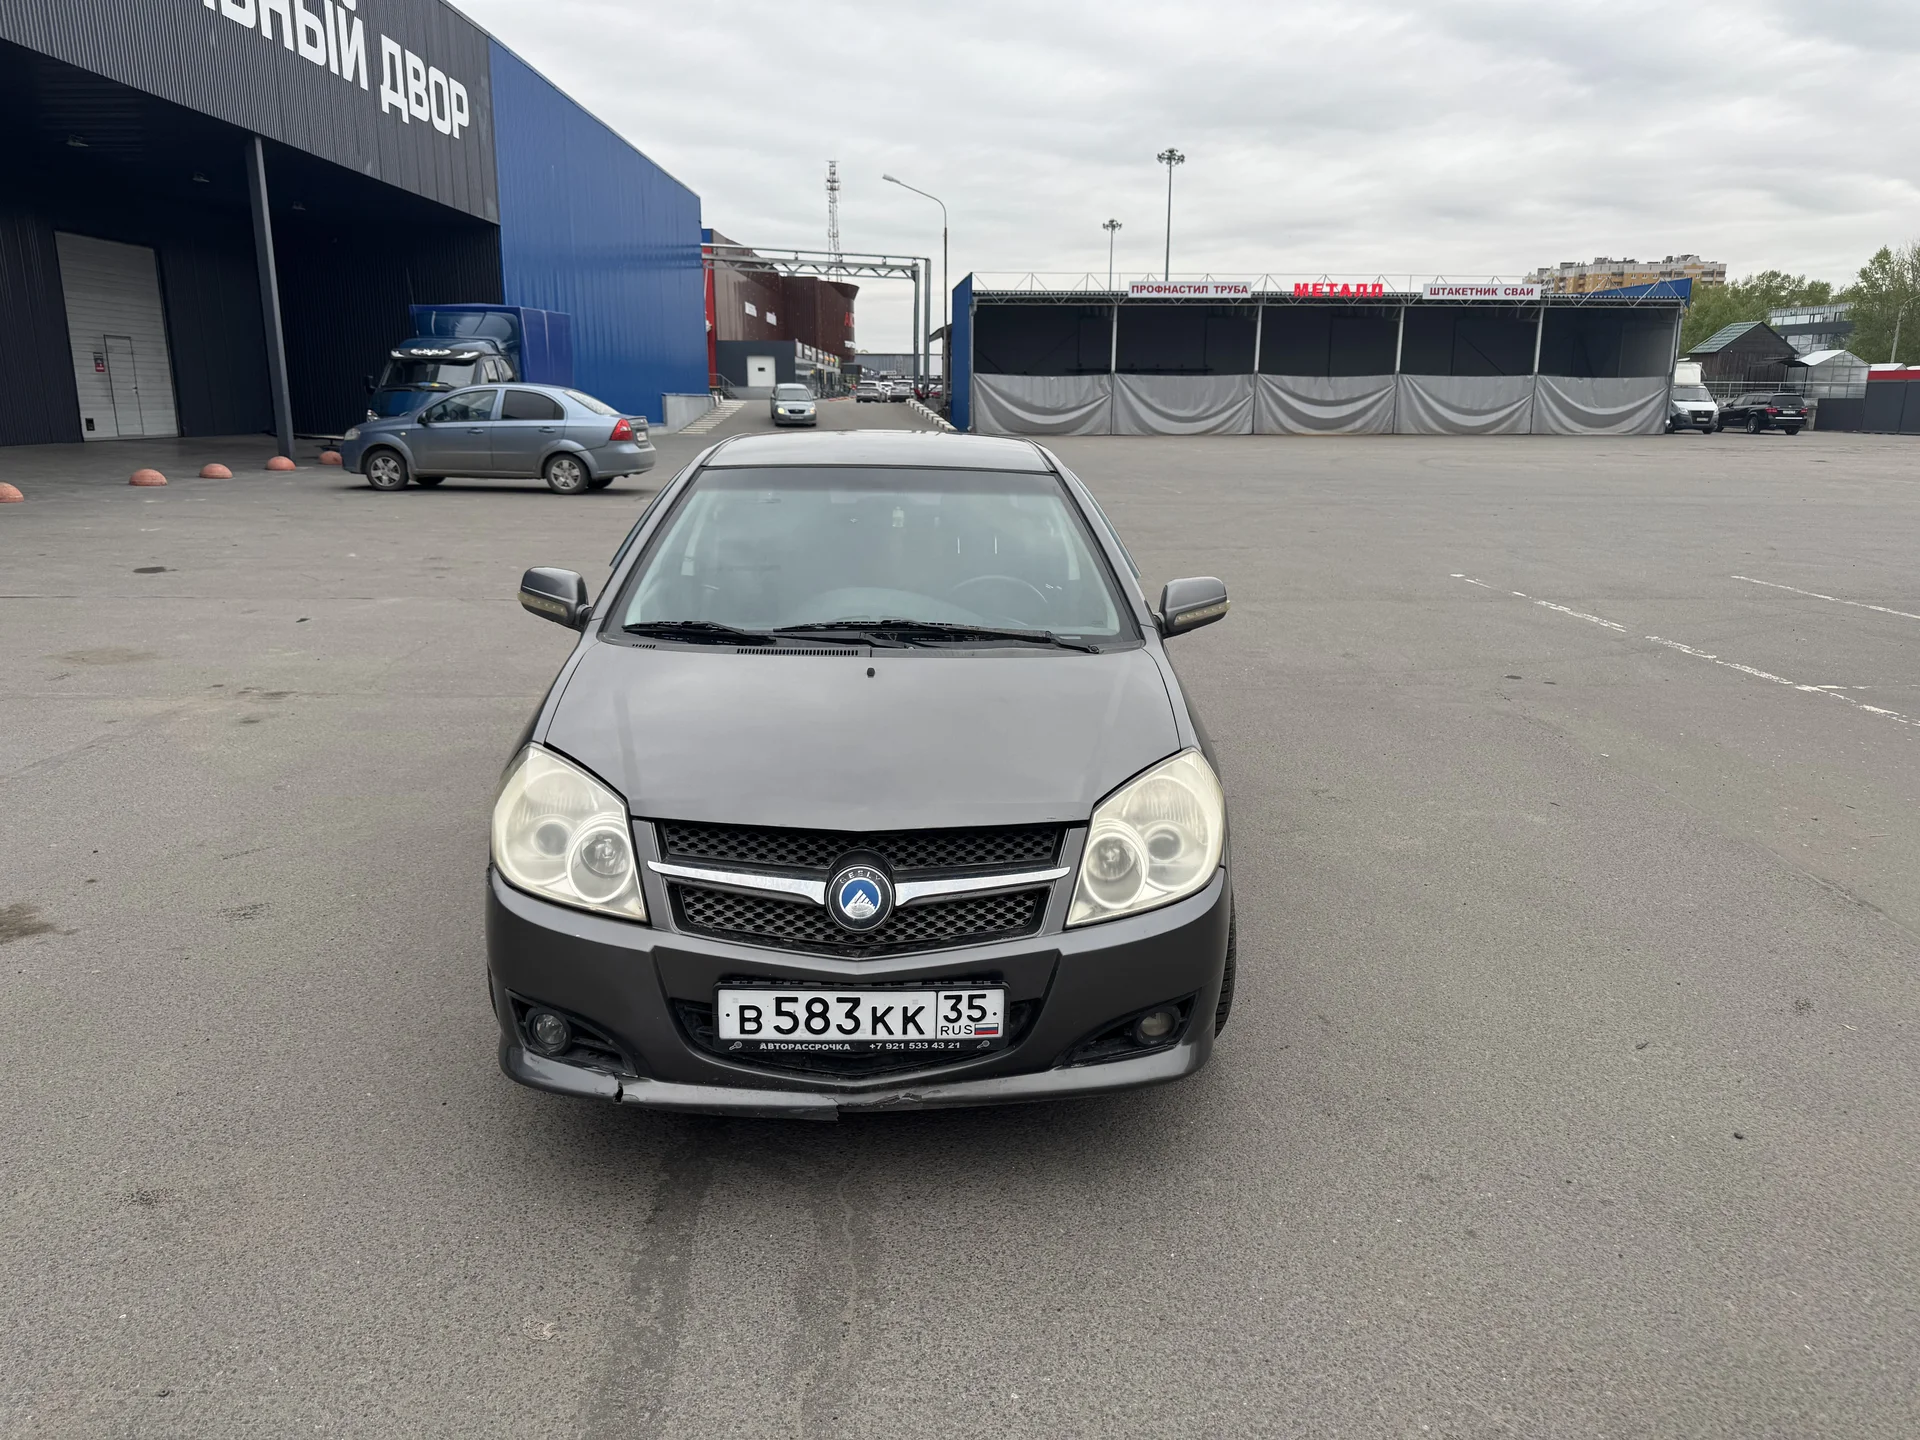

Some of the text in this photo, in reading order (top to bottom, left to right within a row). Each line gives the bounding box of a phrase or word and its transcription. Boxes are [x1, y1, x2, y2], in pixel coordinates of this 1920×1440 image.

[380, 33, 470, 140] ДВОР
[1131, 285, 1248, 294] ПРОФНАСТИЛ ТРУБА
[1293, 283, 1383, 297] МЕТАЛЛ
[1429, 287, 1534, 296] ШТАКЕТНИК СВАИ
[840, 870, 881, 884] GEELY
[943, 993, 988, 1024] 35
[940, 1024, 973, 1036] RUS
[759, 1042, 851, 1051] АВТОРАССРОЧКА
[886, 1042, 905, 1050] 921
[908, 1042, 928, 1050] 533
[947, 1041, 961, 1049] 21
